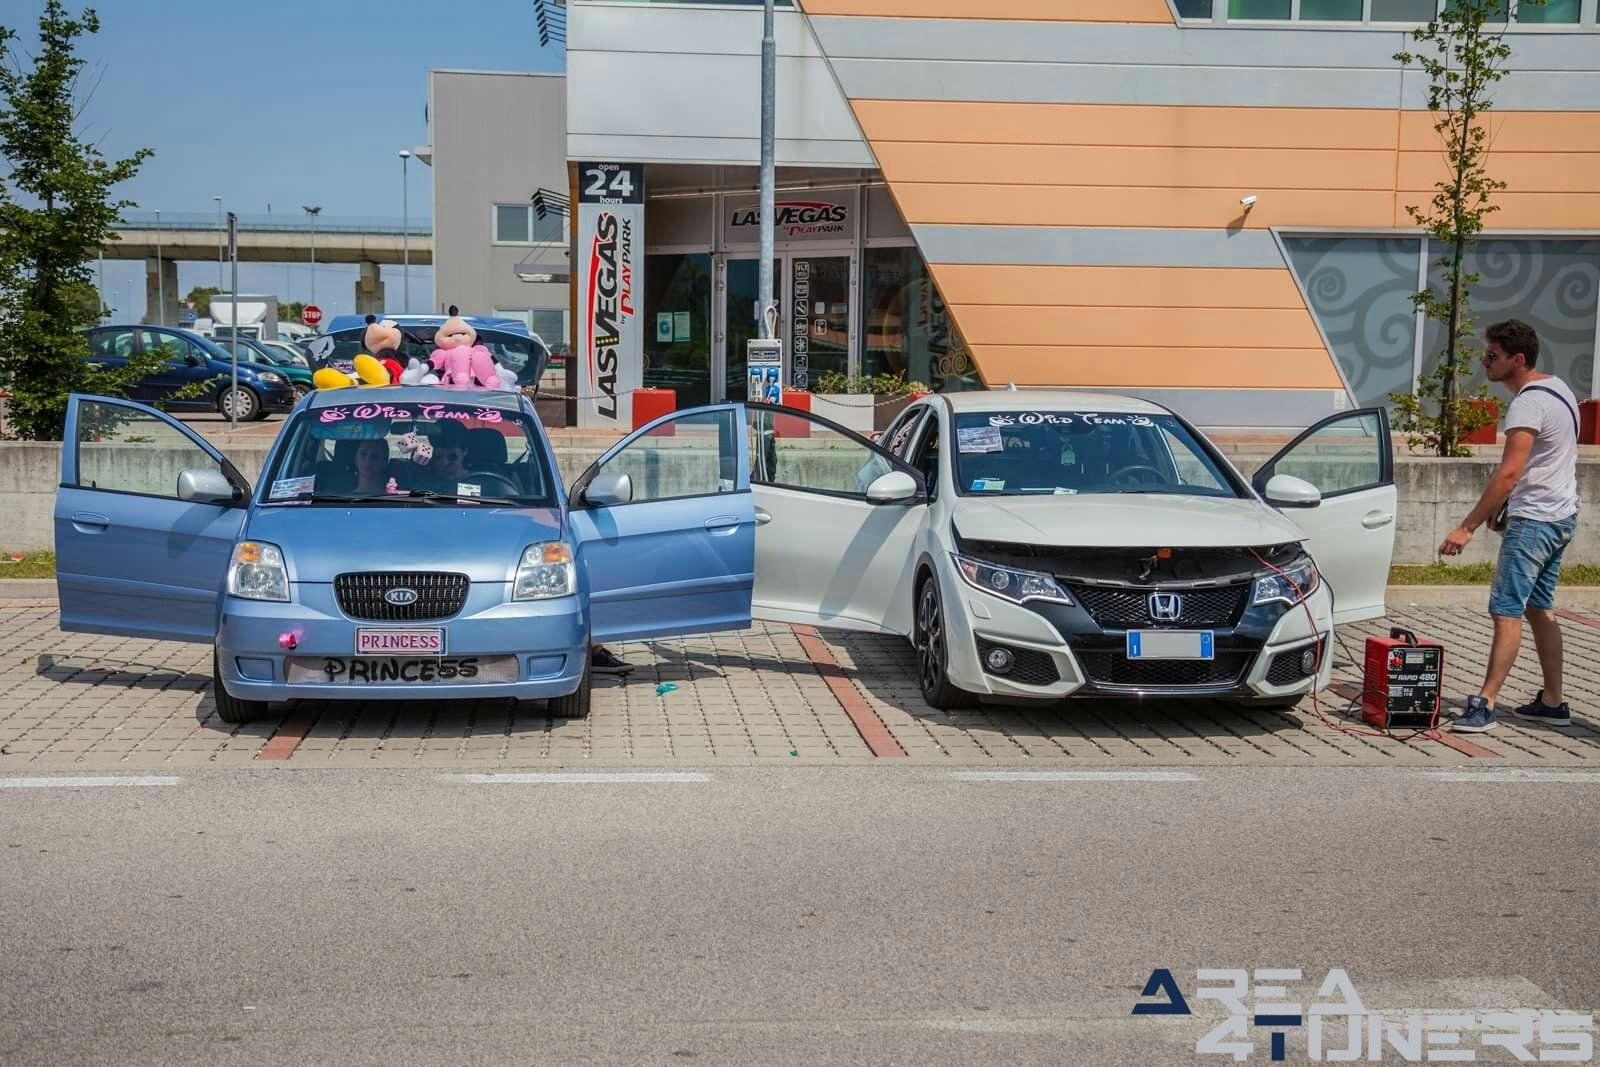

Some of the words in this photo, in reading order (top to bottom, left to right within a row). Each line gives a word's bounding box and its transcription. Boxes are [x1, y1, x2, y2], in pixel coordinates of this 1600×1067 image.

[598, 164, 620, 172] open
[585, 169, 634, 196] 24
[600, 196, 623, 205] hours
[303, 311, 321, 319] STOP
[361, 635, 439, 649] PRINCESS
[323, 657, 479, 683] PRINCESS
